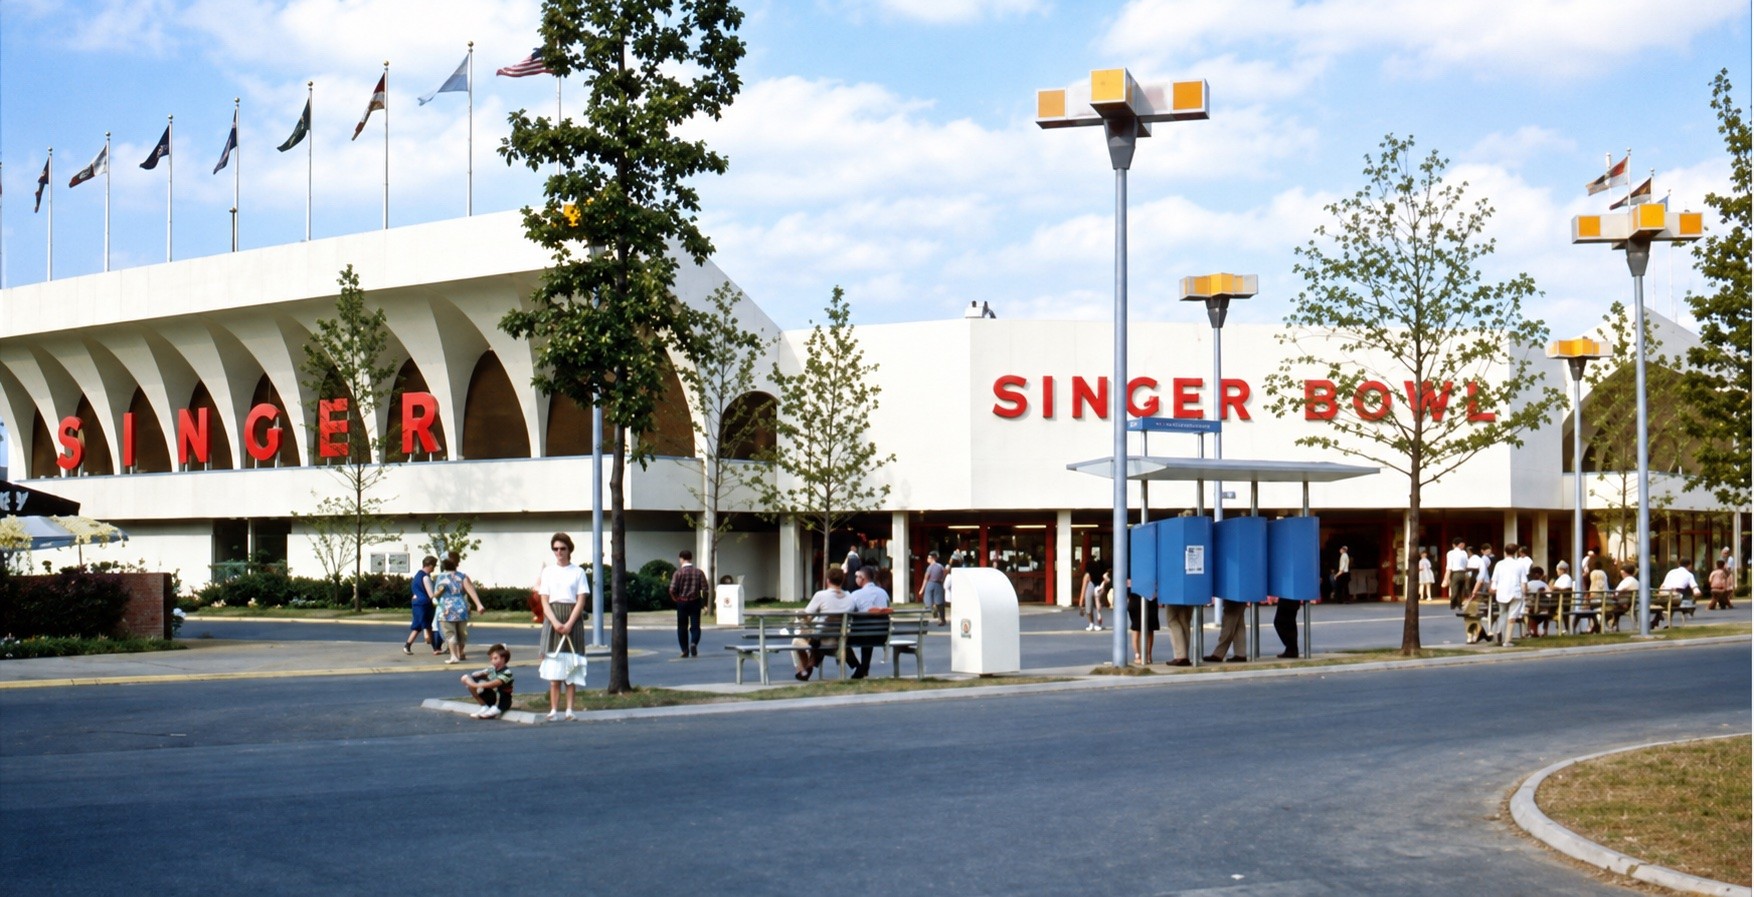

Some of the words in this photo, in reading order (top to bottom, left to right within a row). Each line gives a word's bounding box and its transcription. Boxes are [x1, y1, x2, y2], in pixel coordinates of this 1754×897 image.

[992, 374, 1251, 420] SINGER
[1304, 379, 1496, 422] BOWL
[56, 391, 440, 470] SINGER
